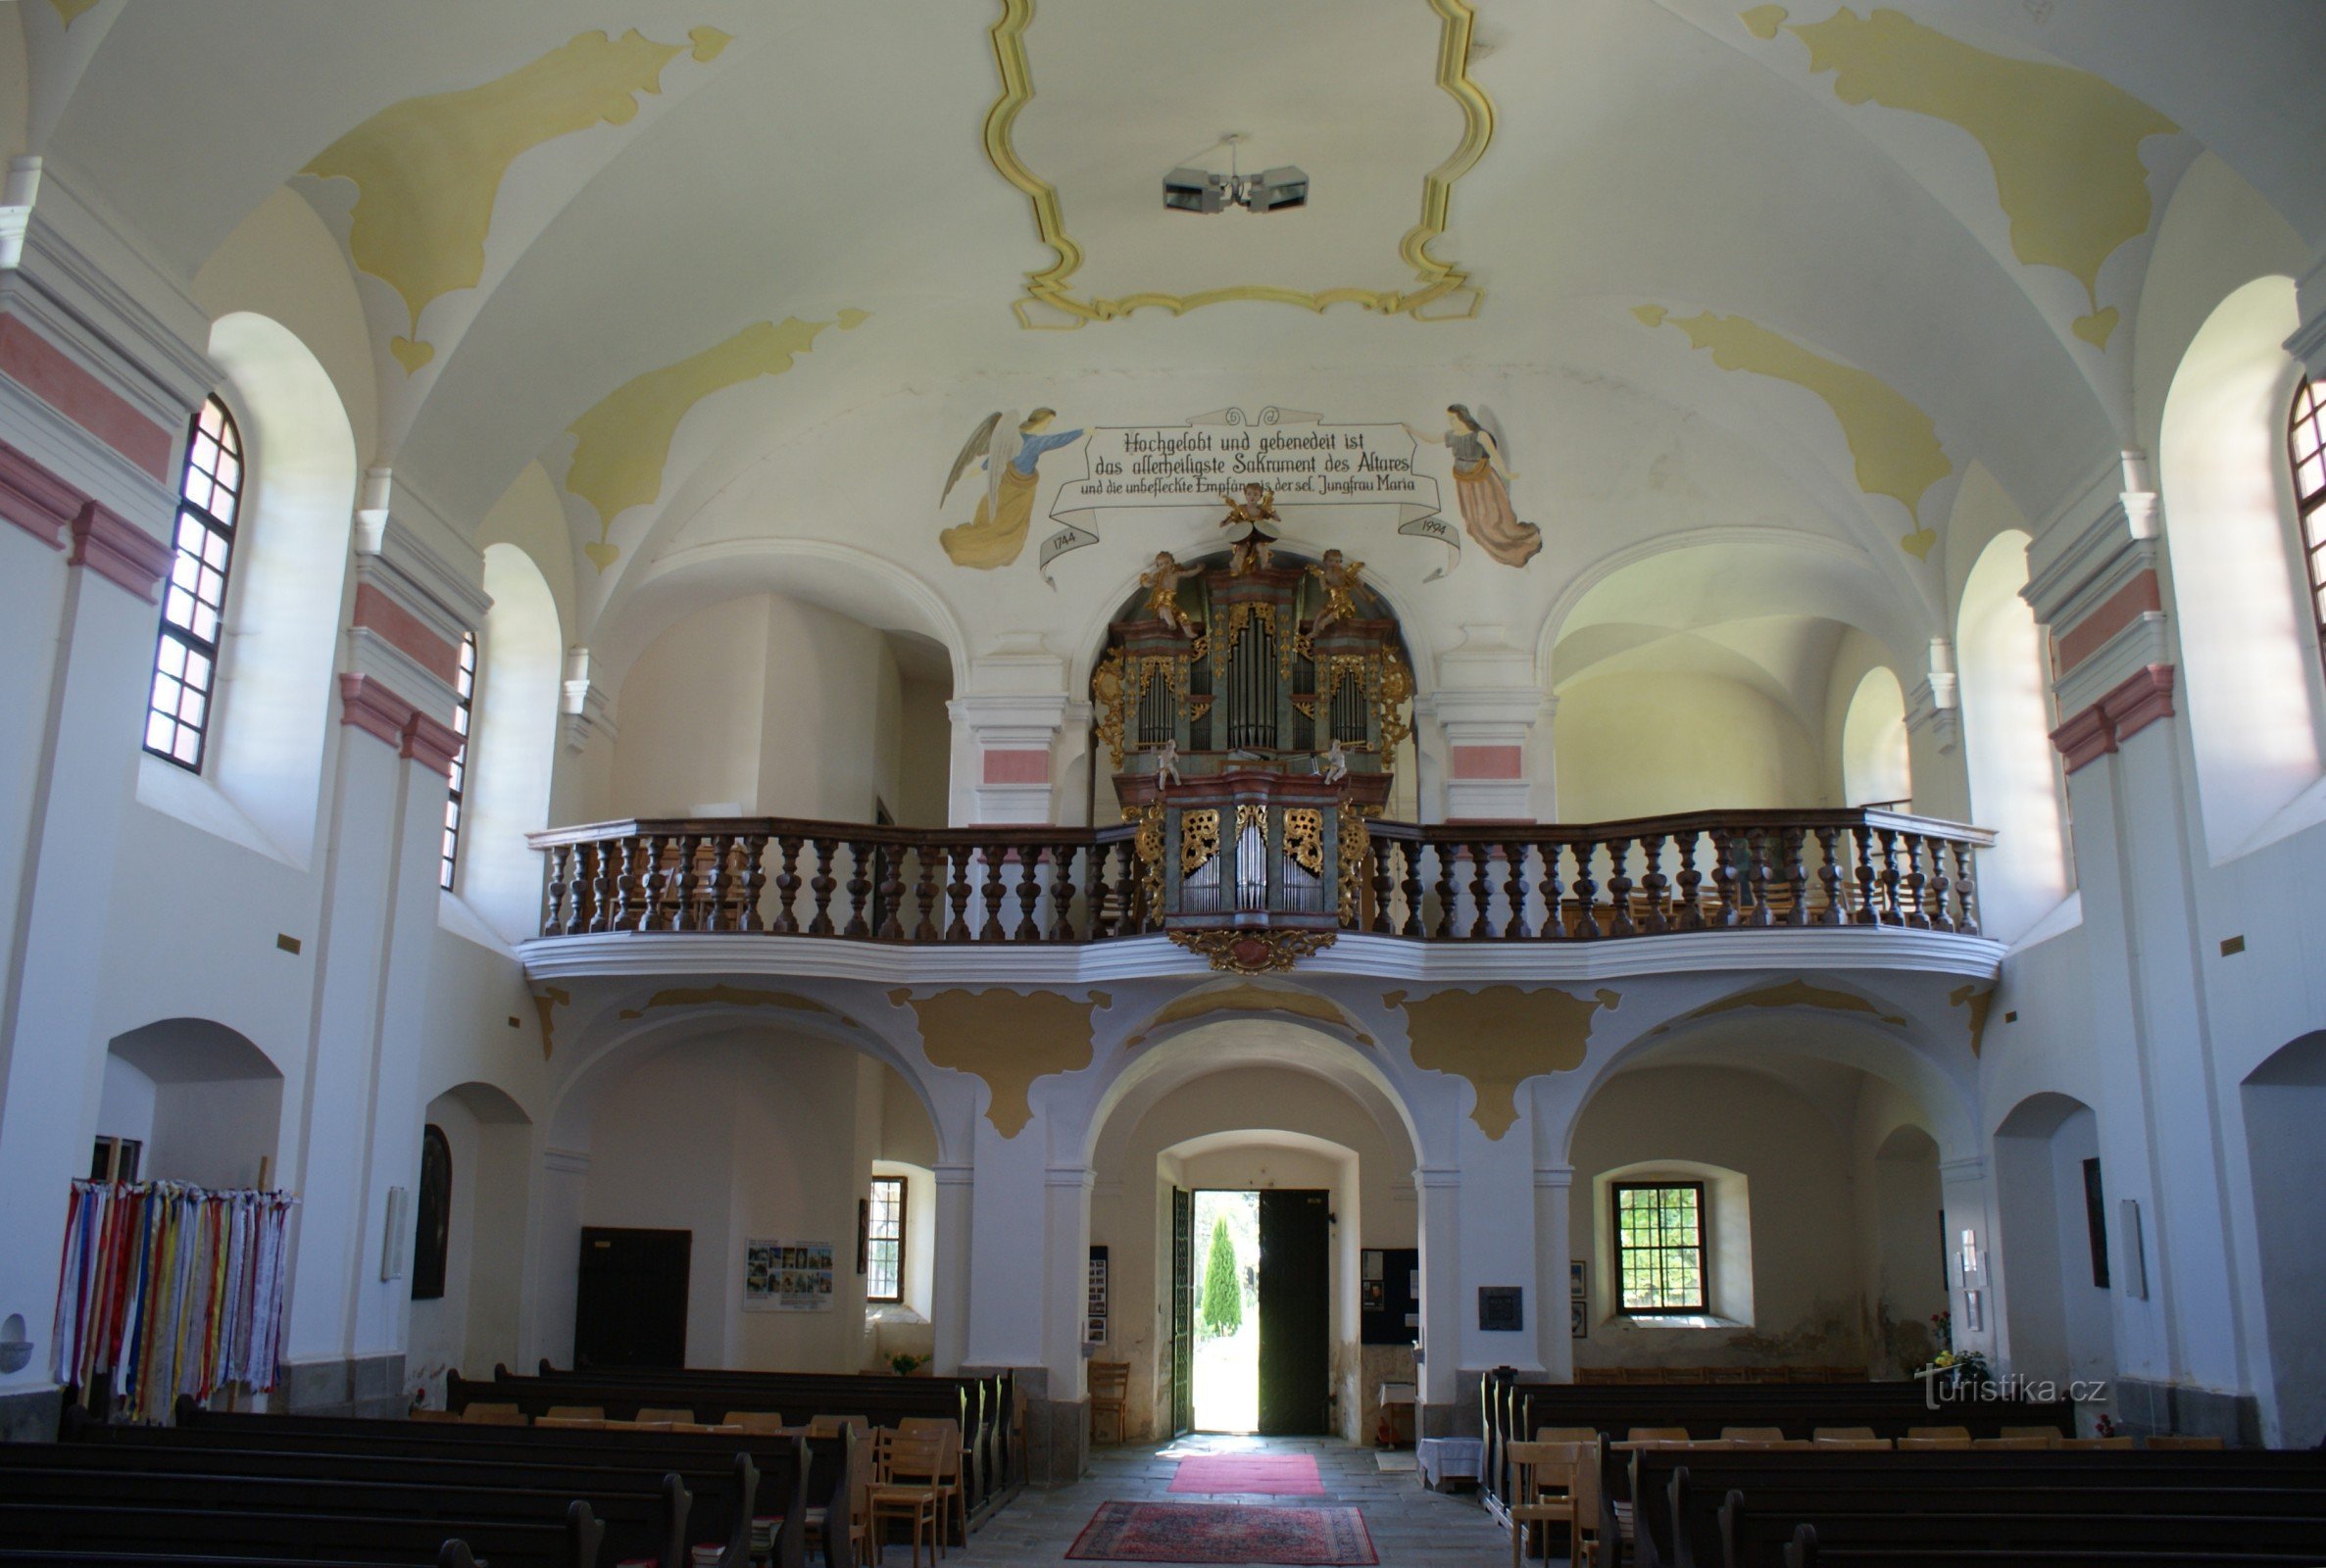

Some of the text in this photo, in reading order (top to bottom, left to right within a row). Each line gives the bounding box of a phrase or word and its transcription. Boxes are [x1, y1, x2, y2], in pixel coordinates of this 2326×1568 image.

[1124, 430, 1363, 456] Hochgelobt und gebenedeit ist
[1095, 456, 1122, 475] das
[1132, 454, 1224, 478] allerheiligste
[1325, 454, 1350, 472] des
[1358, 452, 1410, 472] Altares
[1080, 480, 1103, 495] und
[1106, 479, 1122, 494] die
[1126, 477, 1193, 498] unbefleckte
[1275, 477, 1293, 492] der
[1318, 475, 1372, 497] Jungfrau
[1376, 474, 1414, 491] Maria
[1421, 519, 1446, 535] 1994
[1054, 532, 1076, 550] 1744
